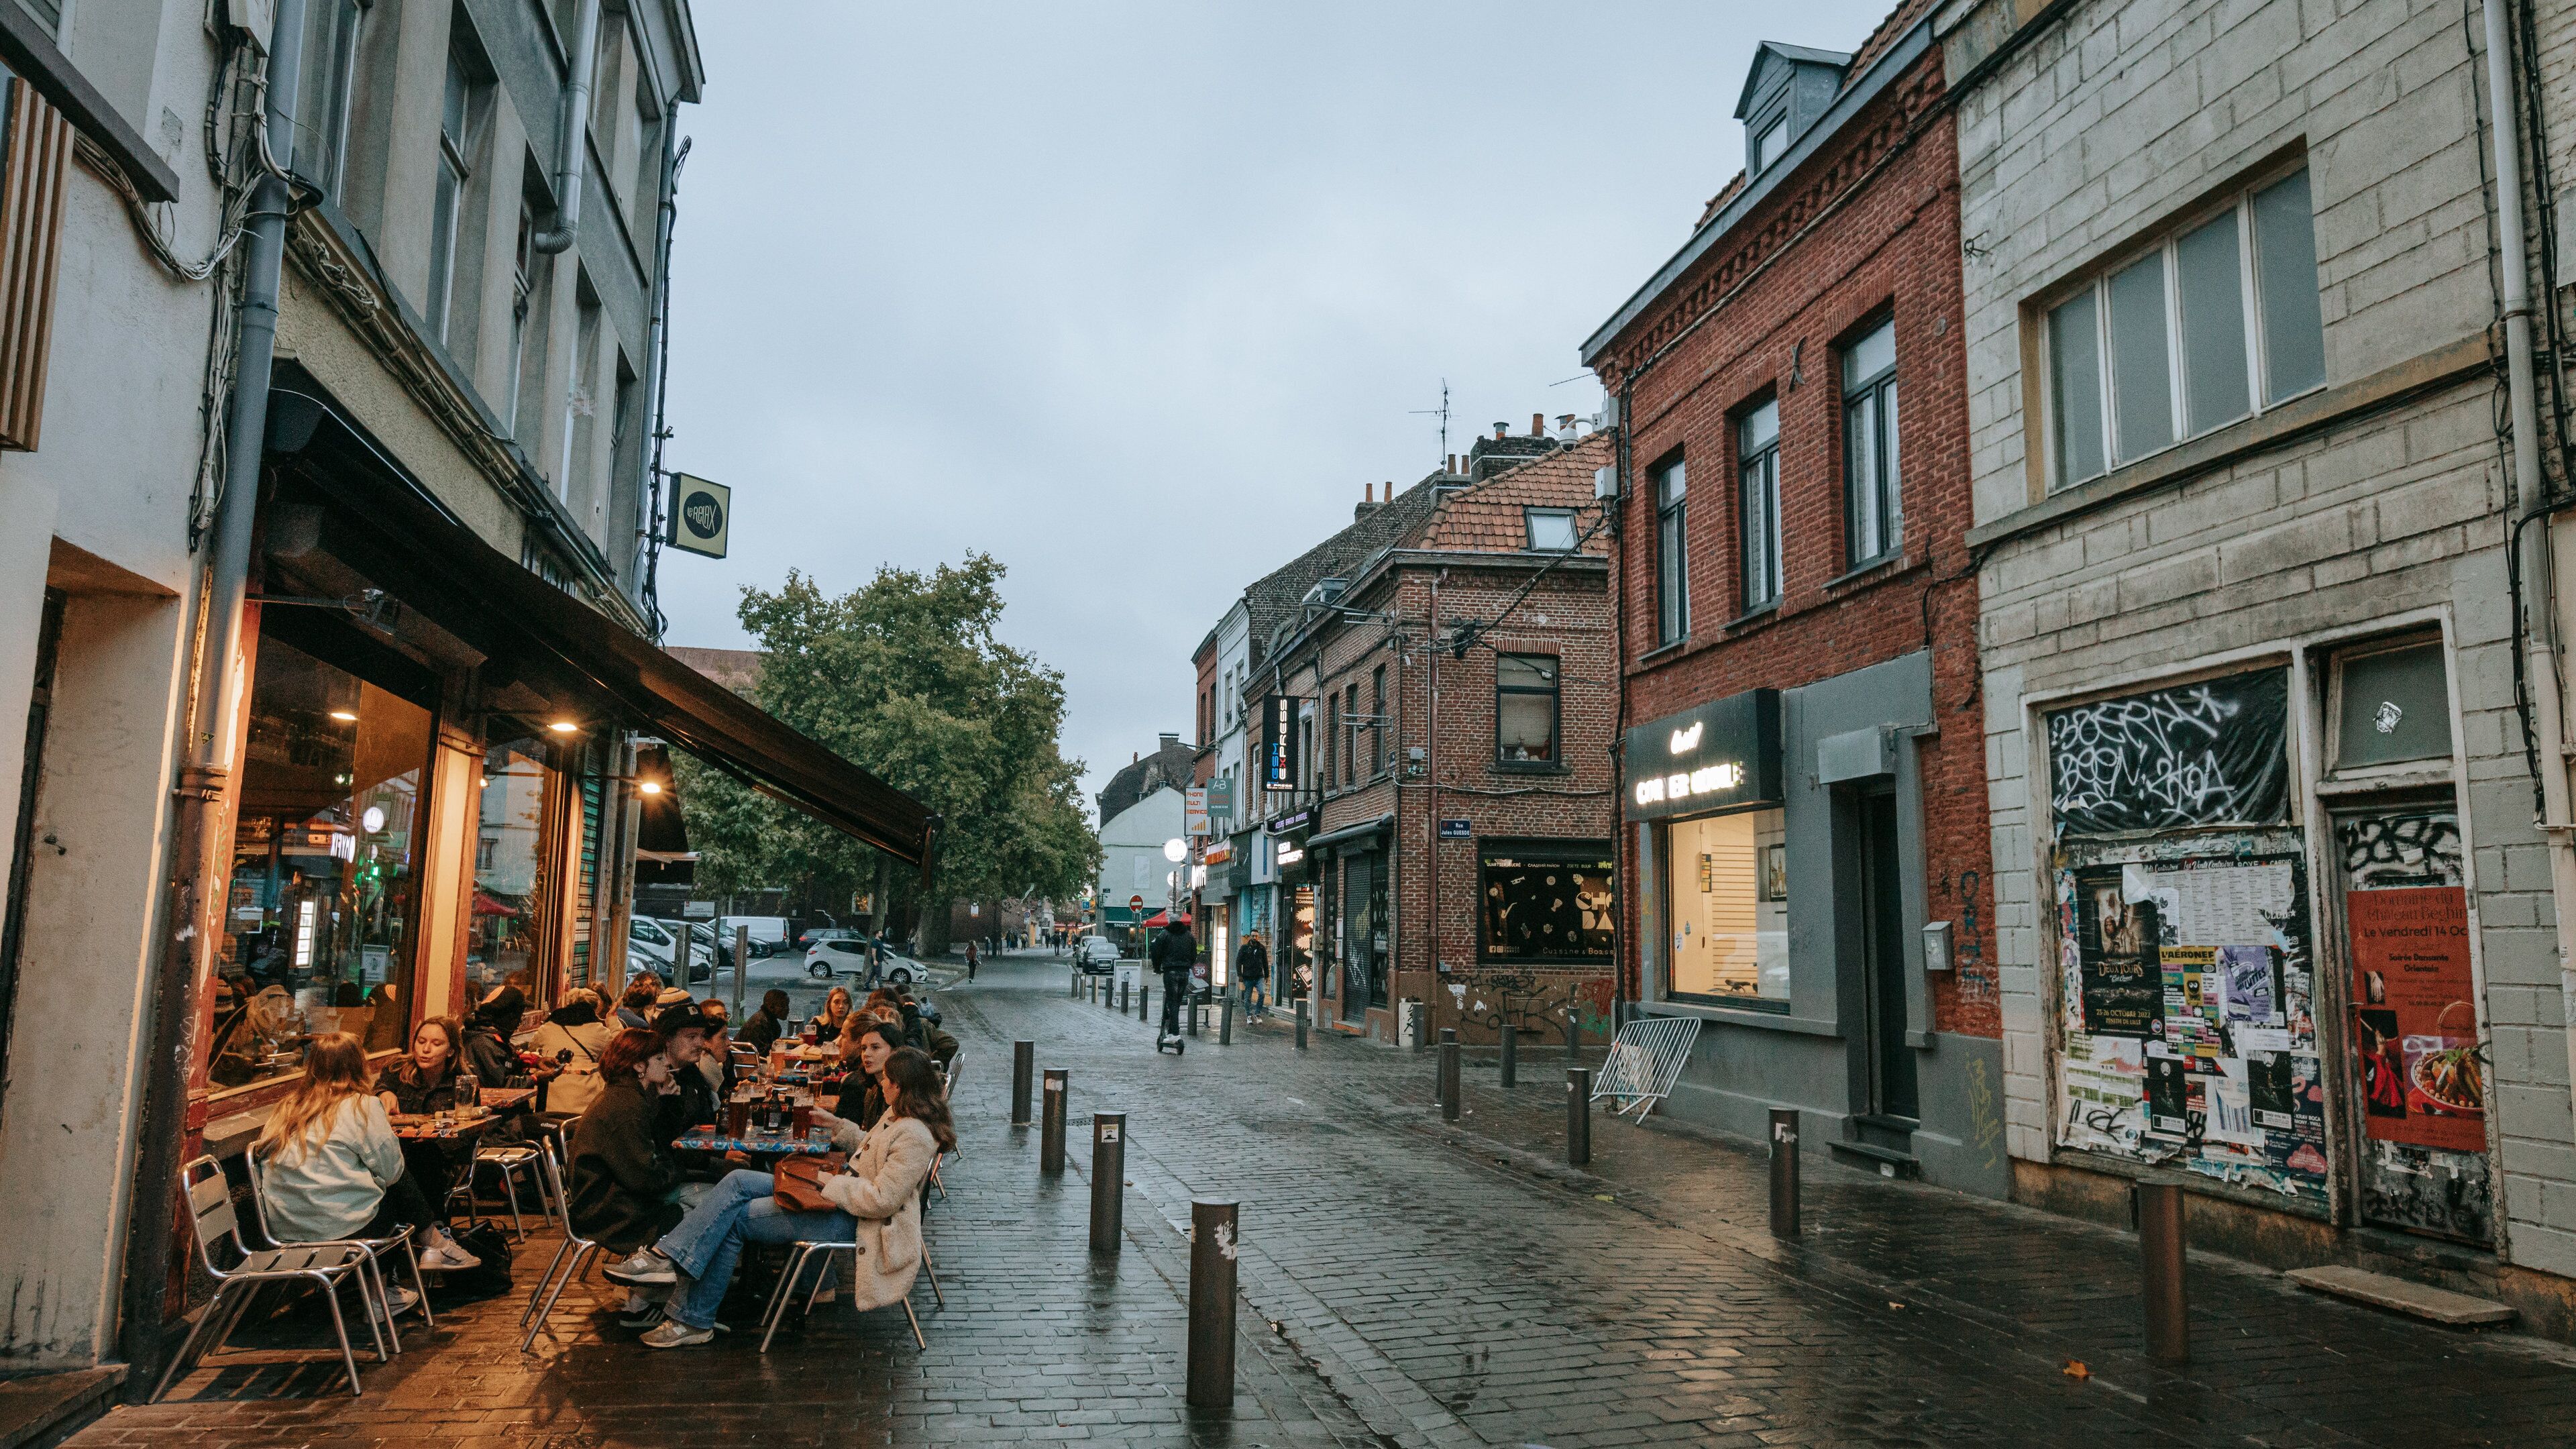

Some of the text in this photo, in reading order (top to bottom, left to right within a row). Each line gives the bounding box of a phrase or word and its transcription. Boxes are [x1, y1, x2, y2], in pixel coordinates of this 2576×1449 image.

[1279, 699, 1287, 780] EXPRESS
[2365, 928, 2375, 937] Le
[2436, 926, 2447, 935] 14
[1543, 947, 1579, 955] Cuisine
[2161, 949, 2214, 959] L'AÉRONEF
[1195, 968, 1205, 976] 30
